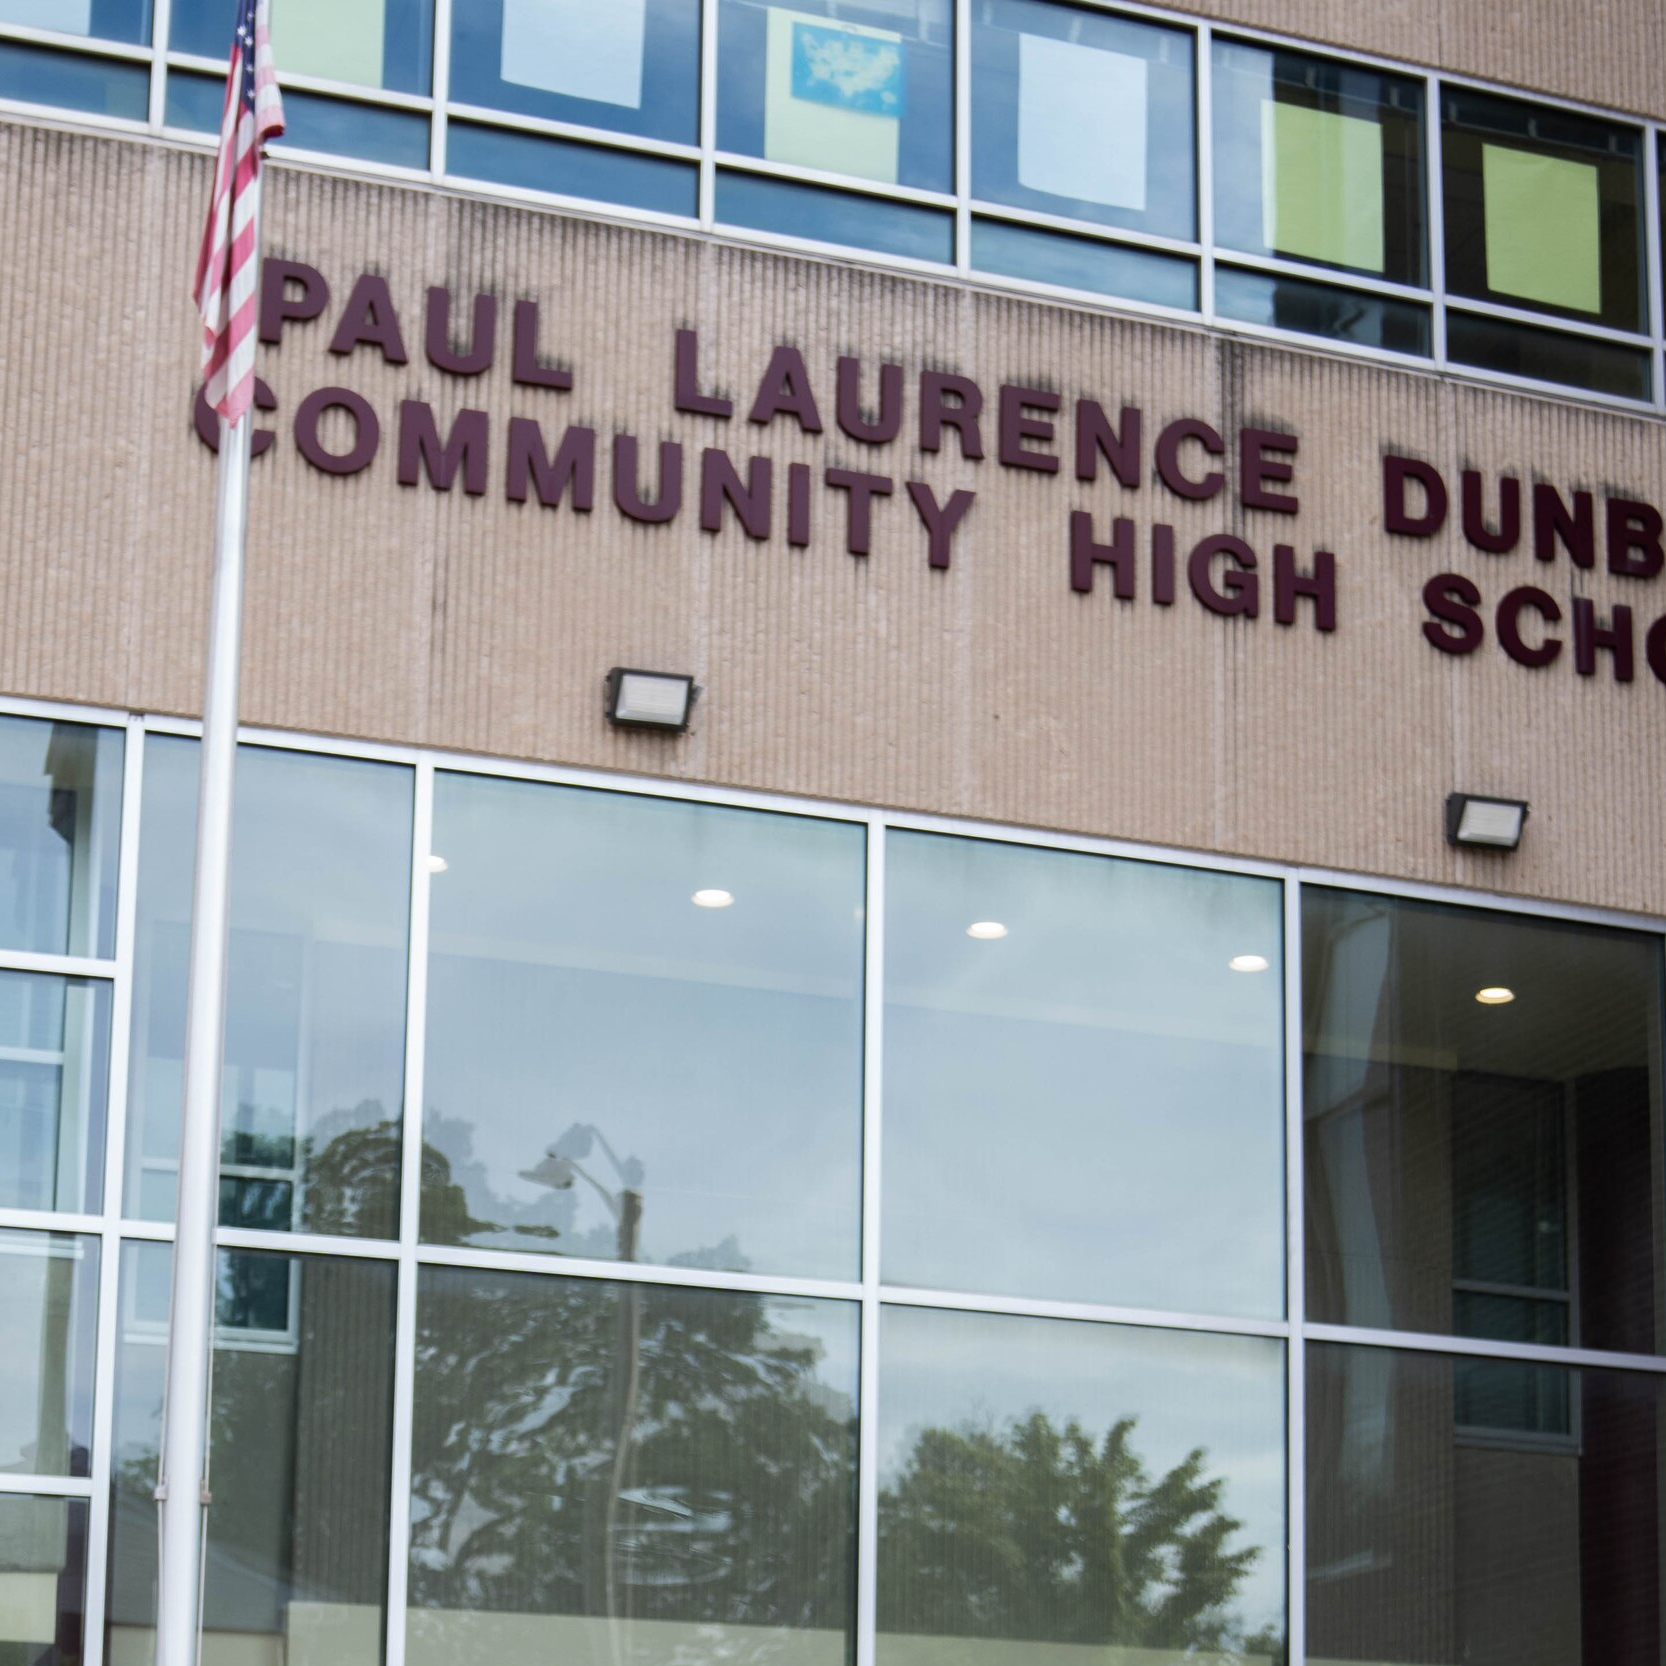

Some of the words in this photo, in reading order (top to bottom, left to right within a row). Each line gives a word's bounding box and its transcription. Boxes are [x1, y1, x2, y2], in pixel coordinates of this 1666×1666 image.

[196, 374, 975, 570] COMMUNITY
[1071, 511, 1338, 632] HIGH
[260, 259, 573, 391] PAUL
[676, 329, 1300, 512] LAURENCE
